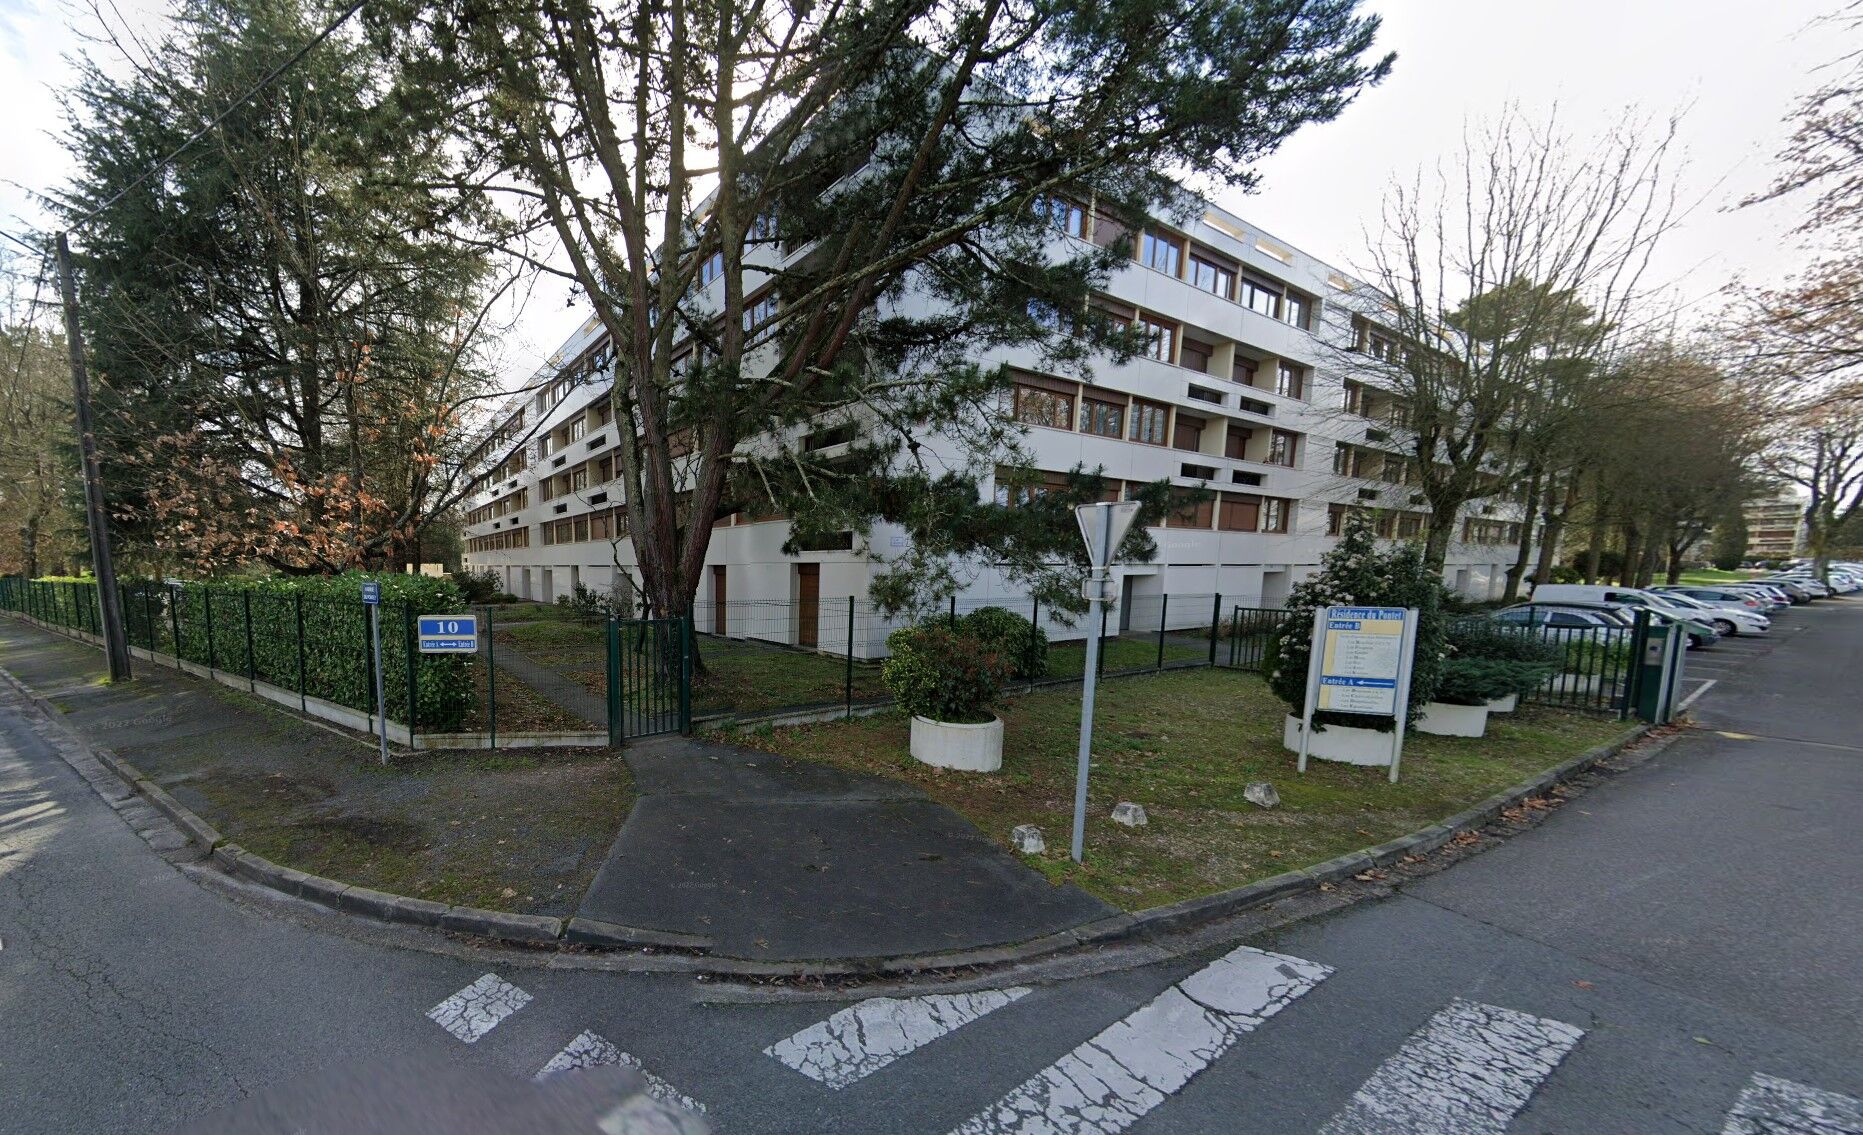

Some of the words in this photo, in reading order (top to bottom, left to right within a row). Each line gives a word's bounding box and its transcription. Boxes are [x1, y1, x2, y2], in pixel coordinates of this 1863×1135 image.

[1331, 609, 1366, 619] Résidence
[1367, 609, 1377, 619] du
[436, 621, 459, 634] 10
[1329, 622, 1352, 630] Entrée
[1322, 677, 1346, 686] Entrée
[1349, 678, 1354, 686] A
